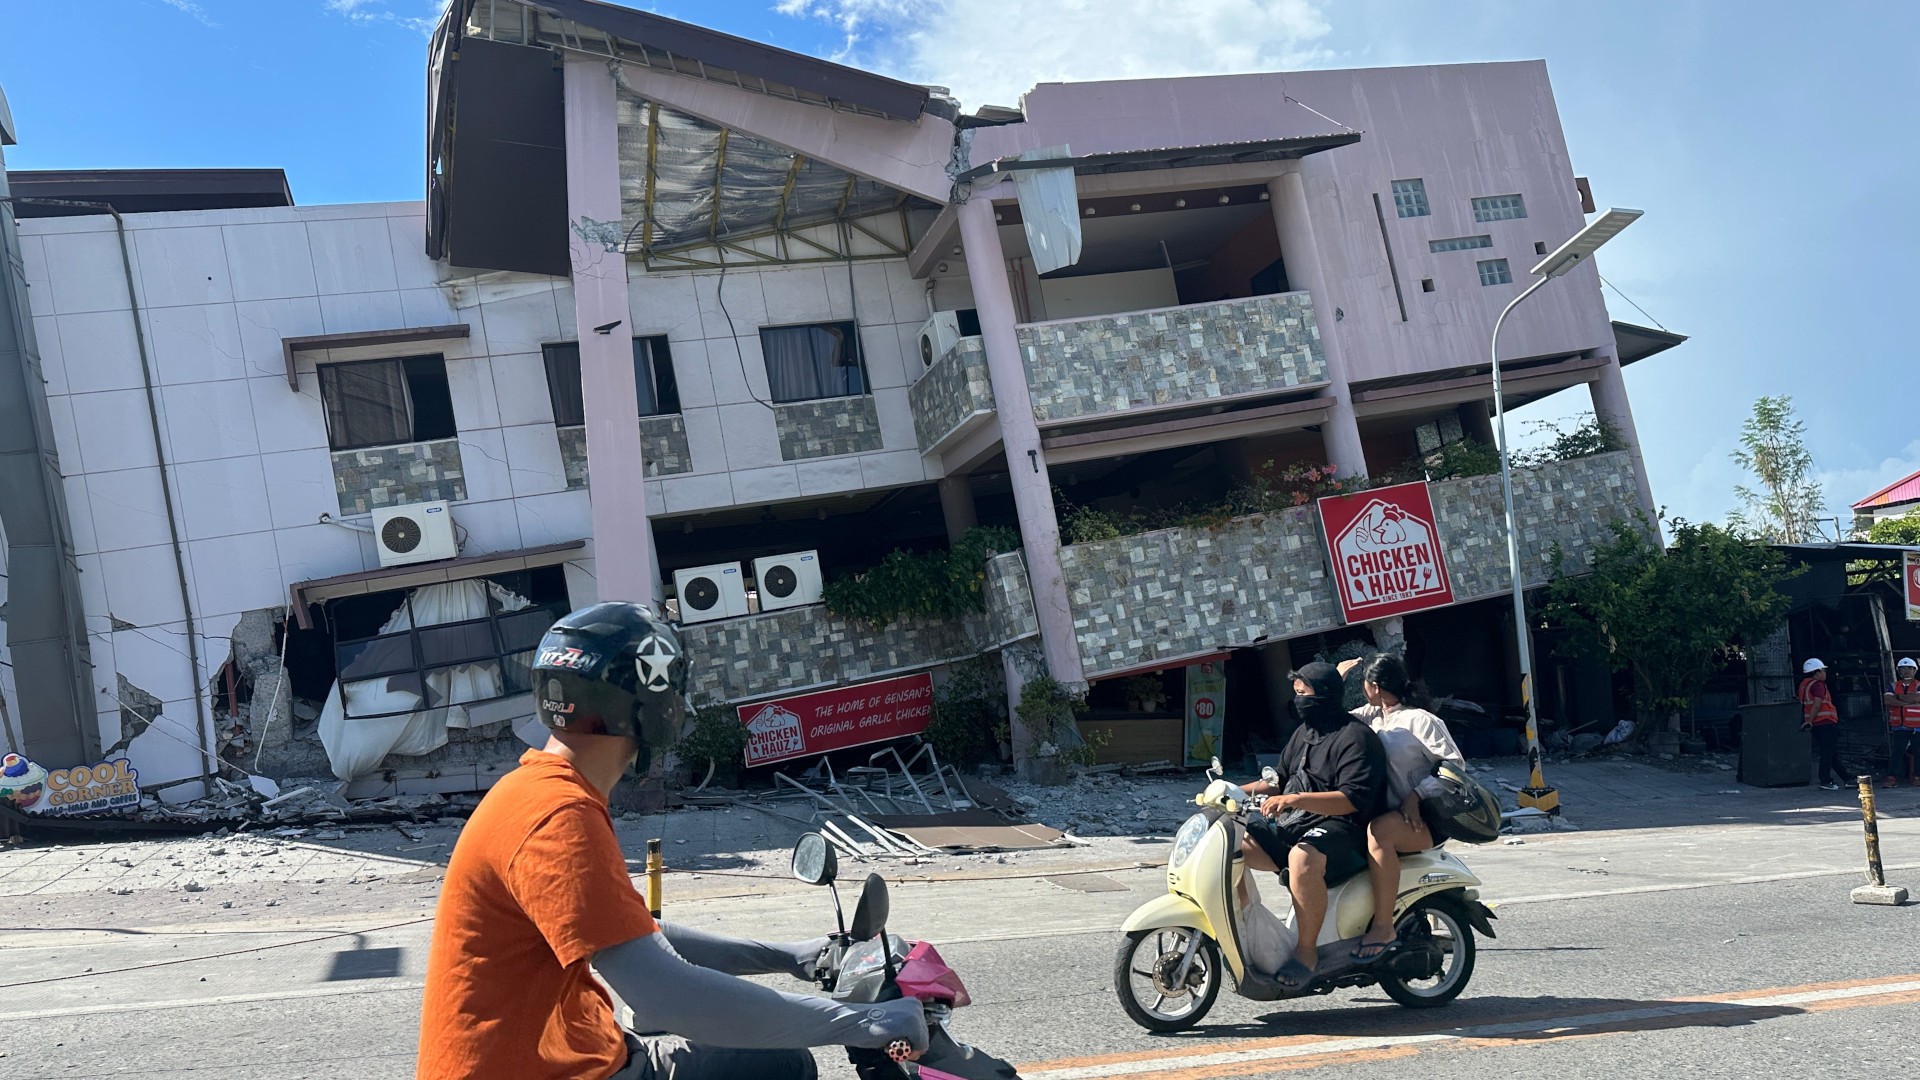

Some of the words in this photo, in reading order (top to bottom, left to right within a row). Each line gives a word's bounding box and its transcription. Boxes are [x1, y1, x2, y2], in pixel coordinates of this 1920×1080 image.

[1346, 543, 1430, 578] CHICKEN
[1368, 568, 1420, 597] HAUZ
[1382, 593, 1398, 602] SINCE
[815, 704, 834, 718] THE
[837, 698, 866, 714] HOME
[868, 696, 882, 708] OF
[884, 685, 931, 705] GENSAN'S
[750, 726, 798, 746] CHICKEN
[810, 720, 855, 738] ORIGINAL
[859, 712, 892, 728] GARLIC
[761, 739, 791, 756] HAUZ
[47, 760, 135, 791] COOL
[49, 780, 137, 806] CORNER
[91, 798, 108, 808] AND
[110, 793, 137, 804] COFFEE
